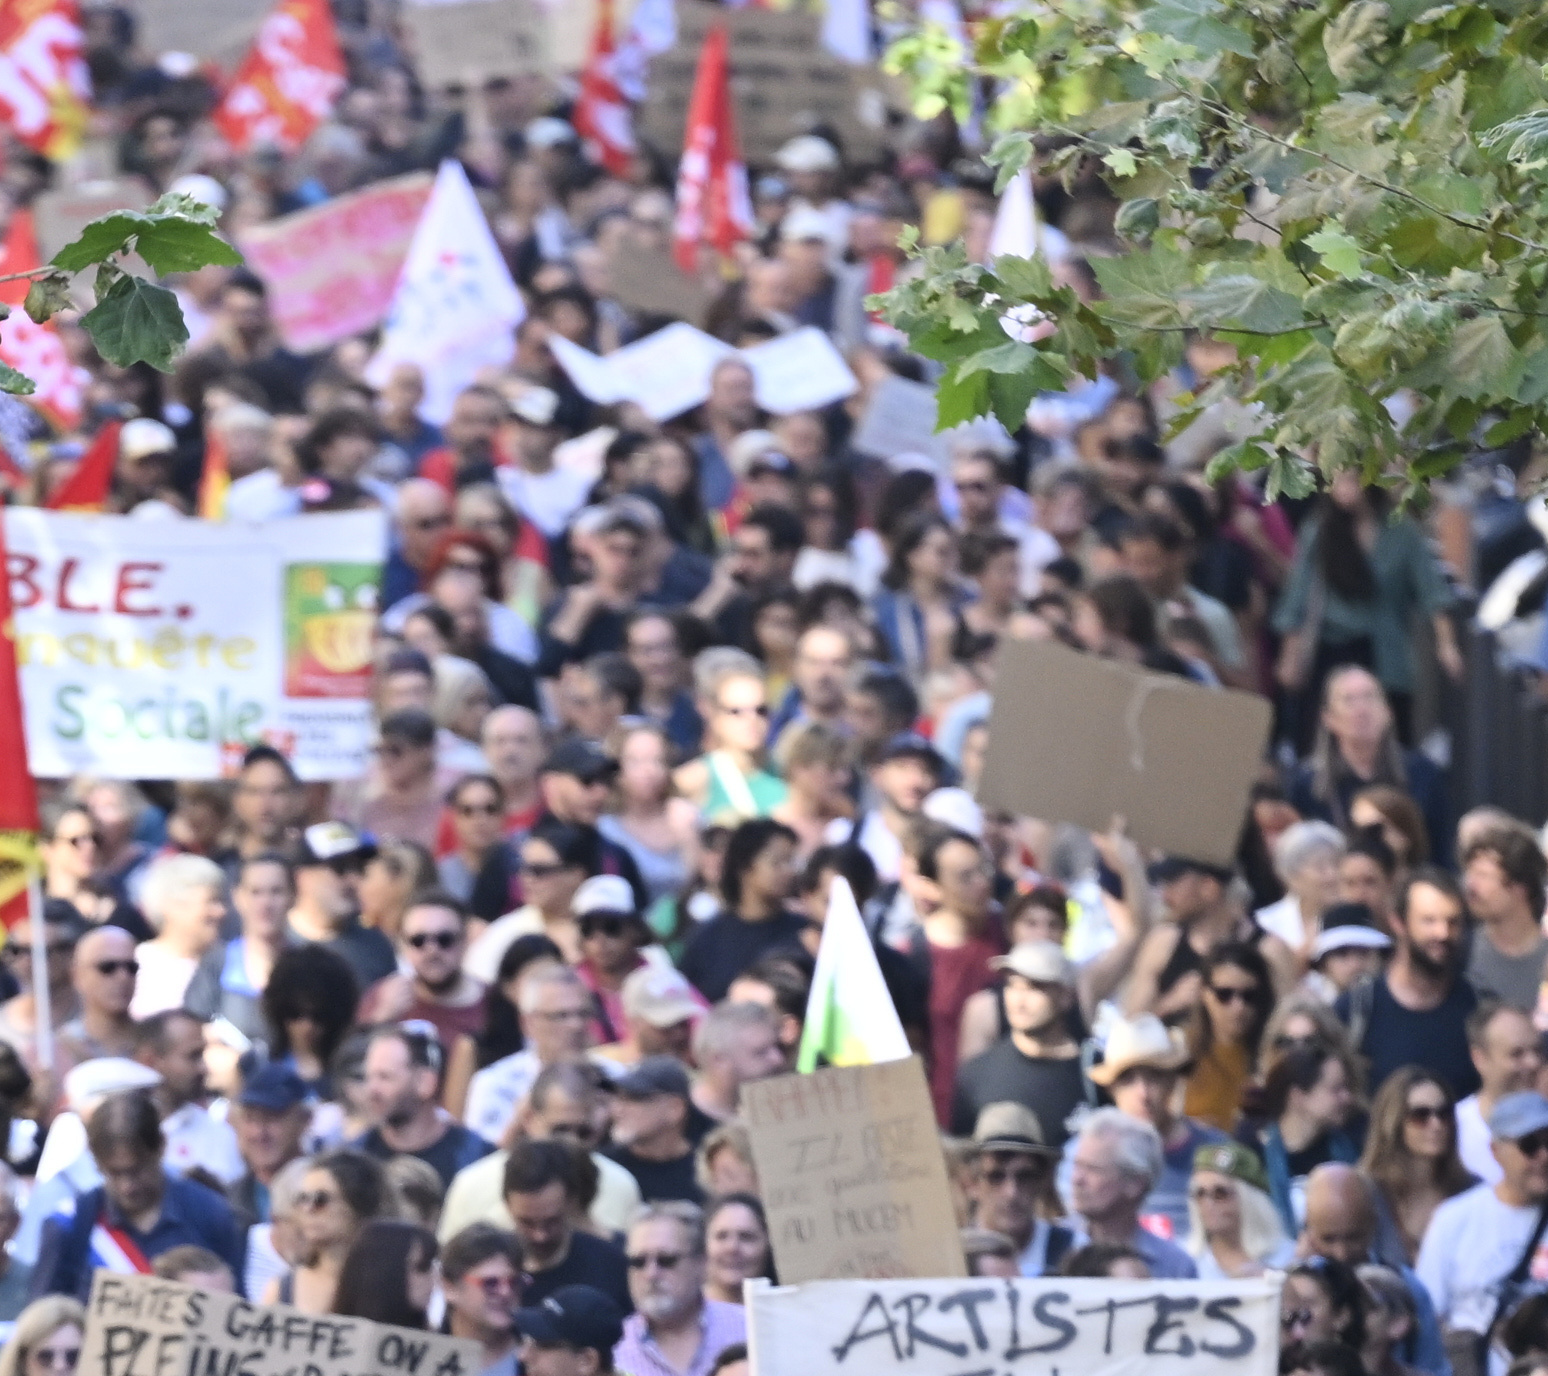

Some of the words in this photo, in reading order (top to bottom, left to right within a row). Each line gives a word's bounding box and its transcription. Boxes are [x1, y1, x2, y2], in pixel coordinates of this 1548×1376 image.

[226, 1302, 356, 1361] GAFFE
[376, 1332, 430, 1373] ON
[832, 1289, 1257, 1363] ARTISTES
